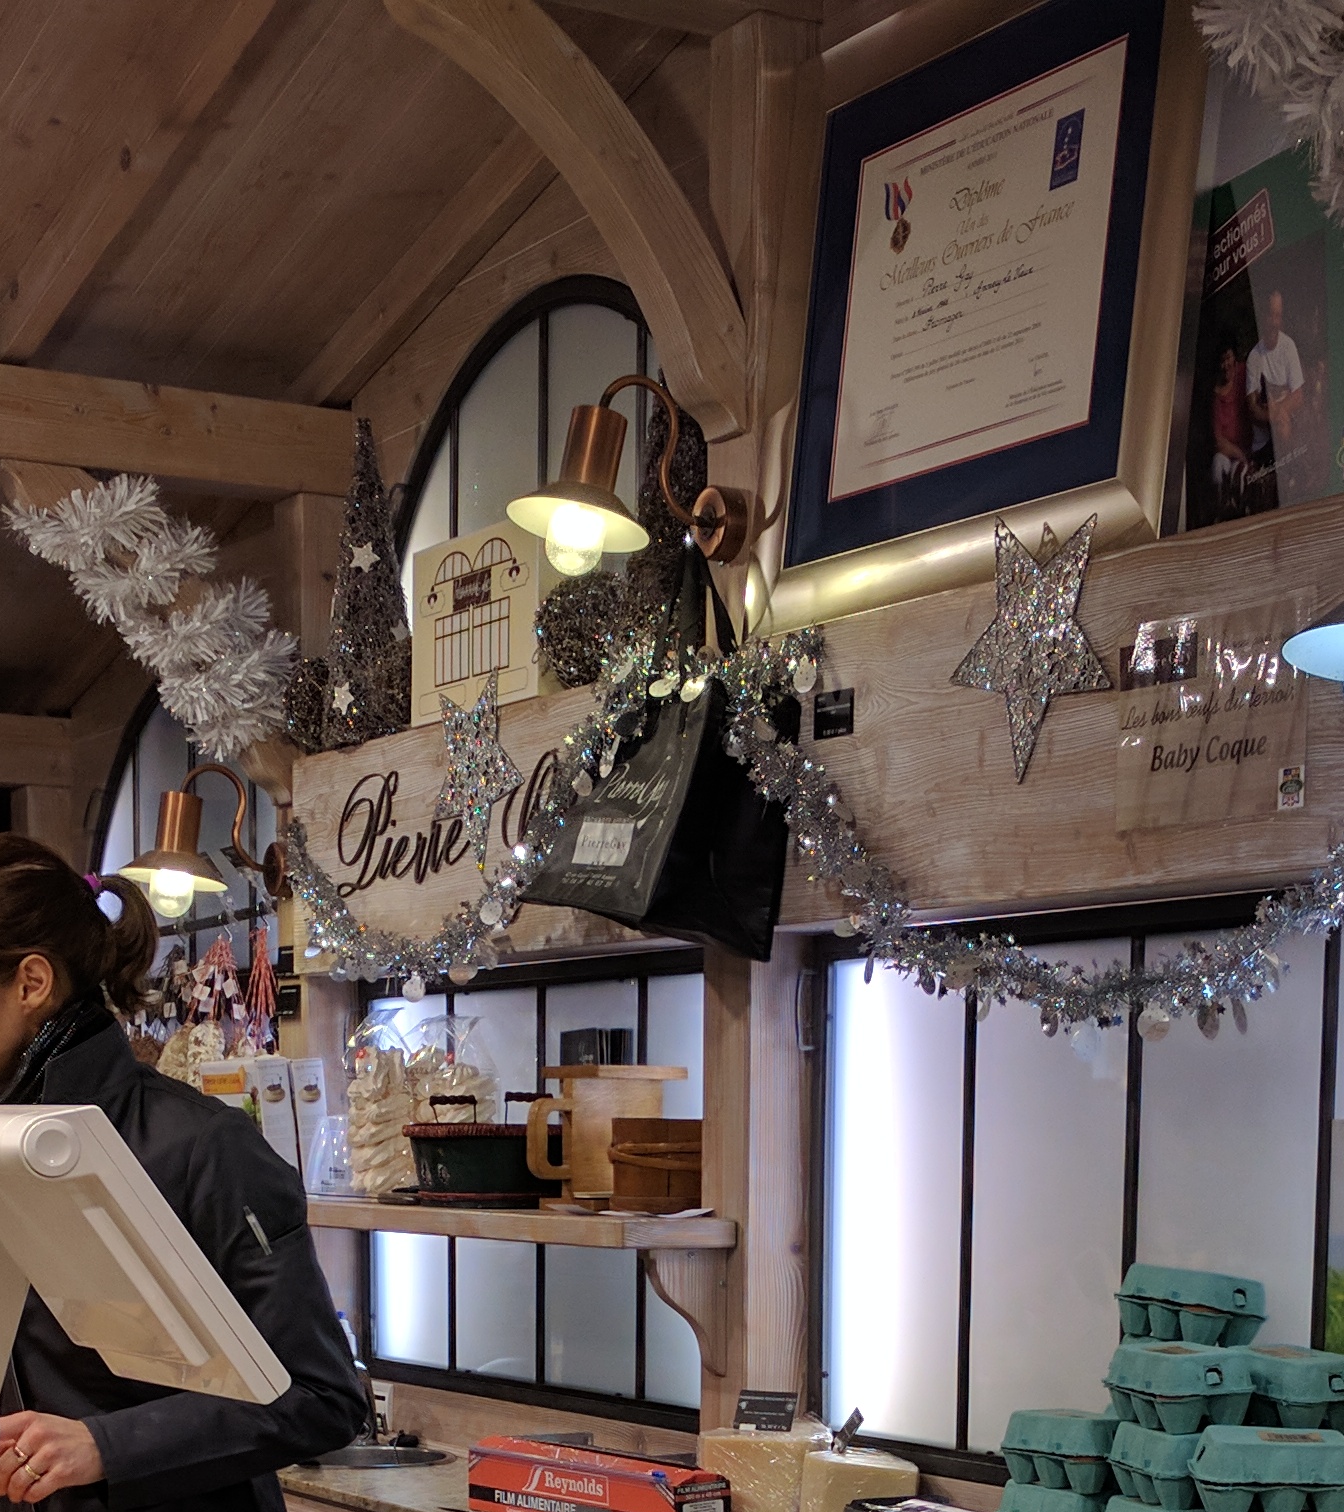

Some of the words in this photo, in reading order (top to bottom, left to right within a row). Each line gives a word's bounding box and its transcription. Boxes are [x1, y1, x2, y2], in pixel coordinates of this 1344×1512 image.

[1013, 108, 1053, 137] NATIONALE
[948, 179, 1005, 214] Diplôme
[997, 219, 1013, 244] de
[1016, 201, 1075, 244] France
[1122, 706, 1147, 730] Les
[1152, 701, 1181, 725] bons
[1224, 687, 1244, 712] du
[1151, 743, 1200, 773] Baby
[1206, 735, 1267, 764] Coque
[337, 771, 471, 898] Pierre
[495, 1489, 517, 1505] FILM
[544, 1471, 604, 1497] Reynolds
